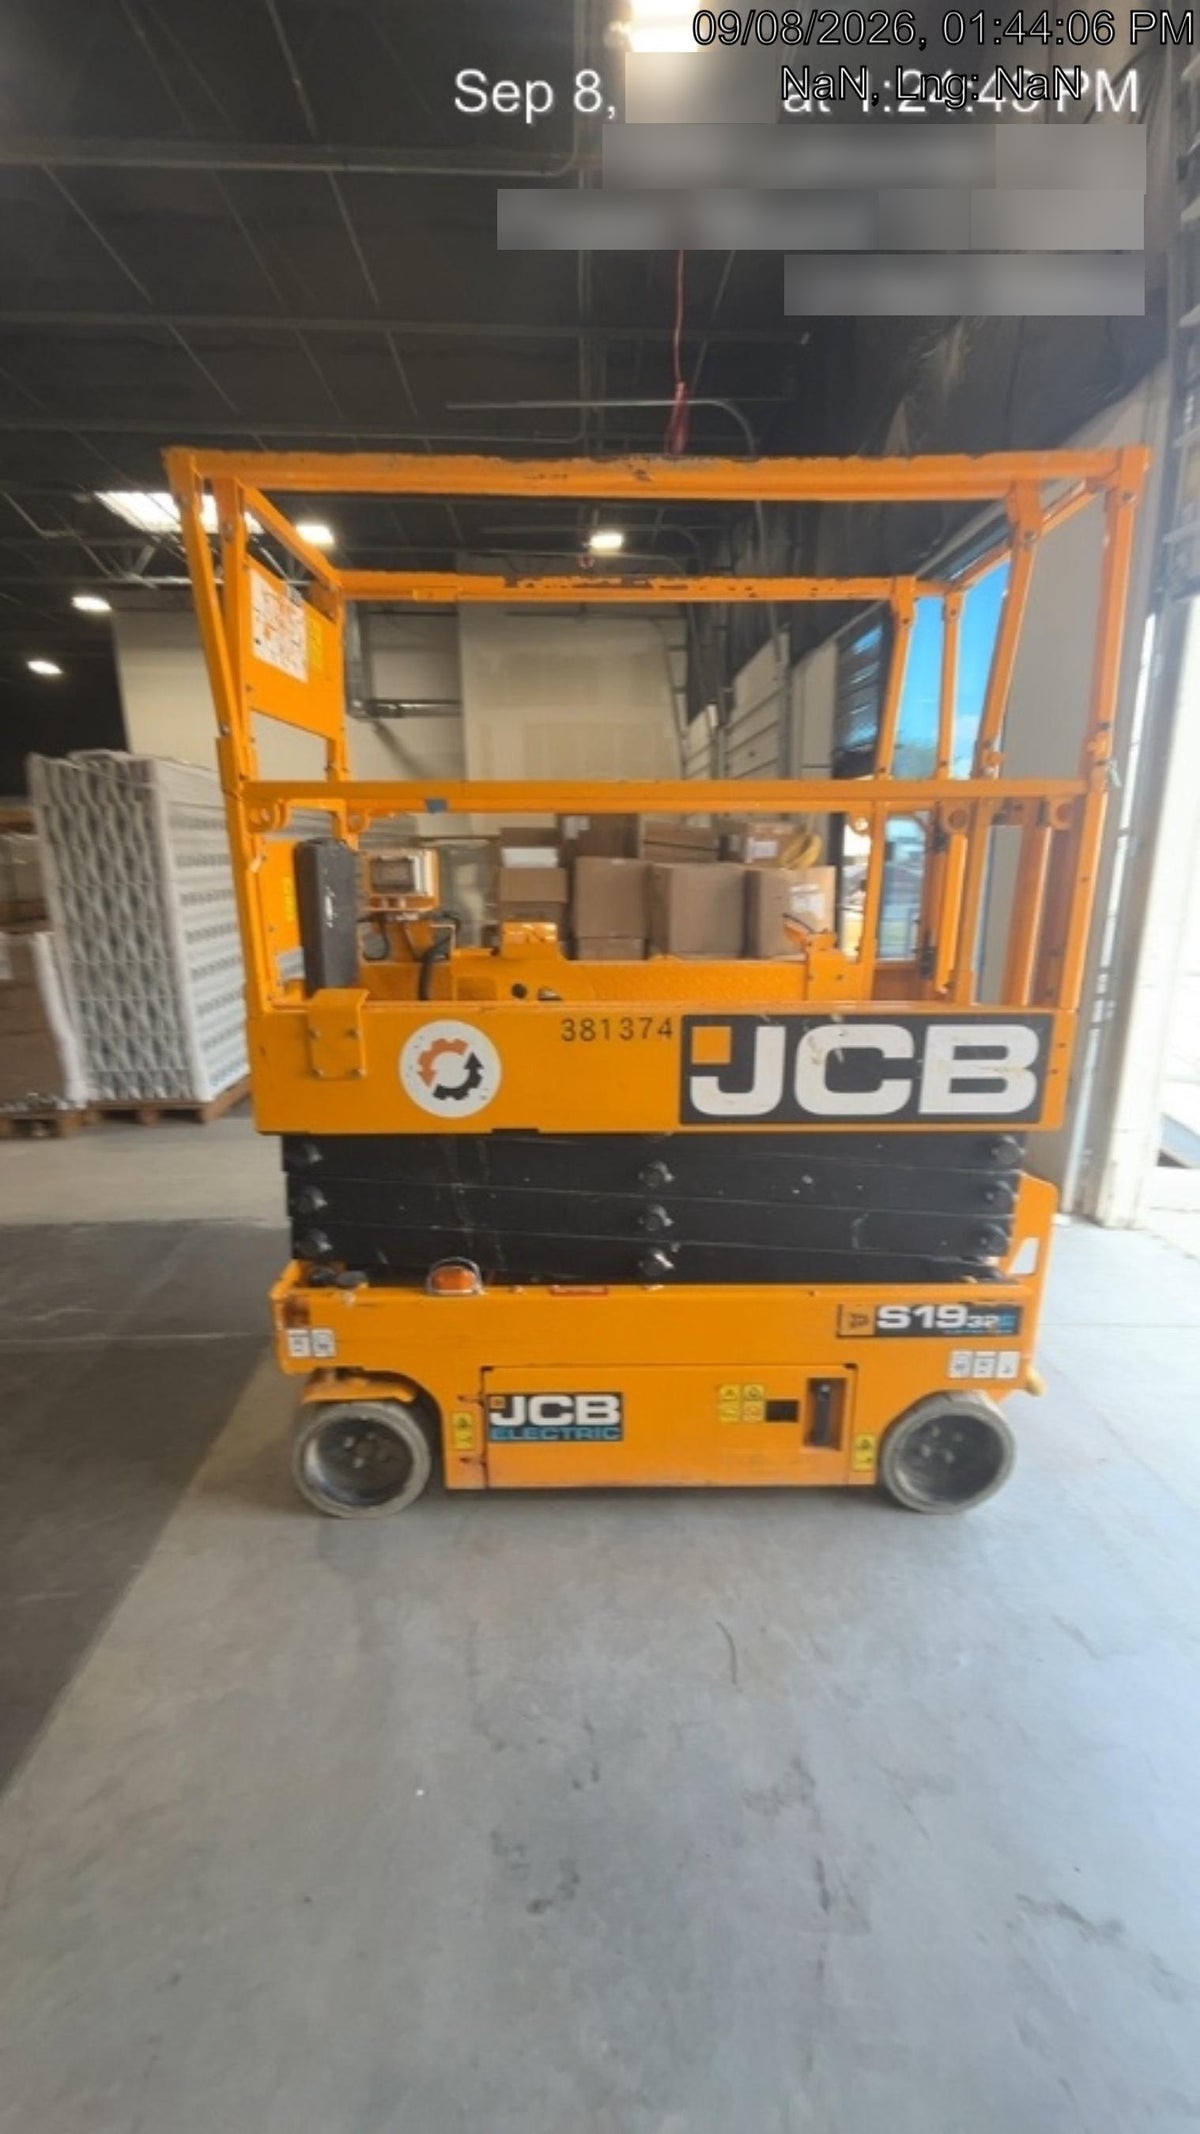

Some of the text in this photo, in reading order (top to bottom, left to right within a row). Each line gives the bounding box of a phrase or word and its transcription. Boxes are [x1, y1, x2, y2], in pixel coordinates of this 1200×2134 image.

[560, 1016, 673, 1041] 381374
[690, 1024, 1040, 1115] JCB
[489, 1395, 620, 1426] JCB
[491, 1426, 621, 1441] ELECTRIC
